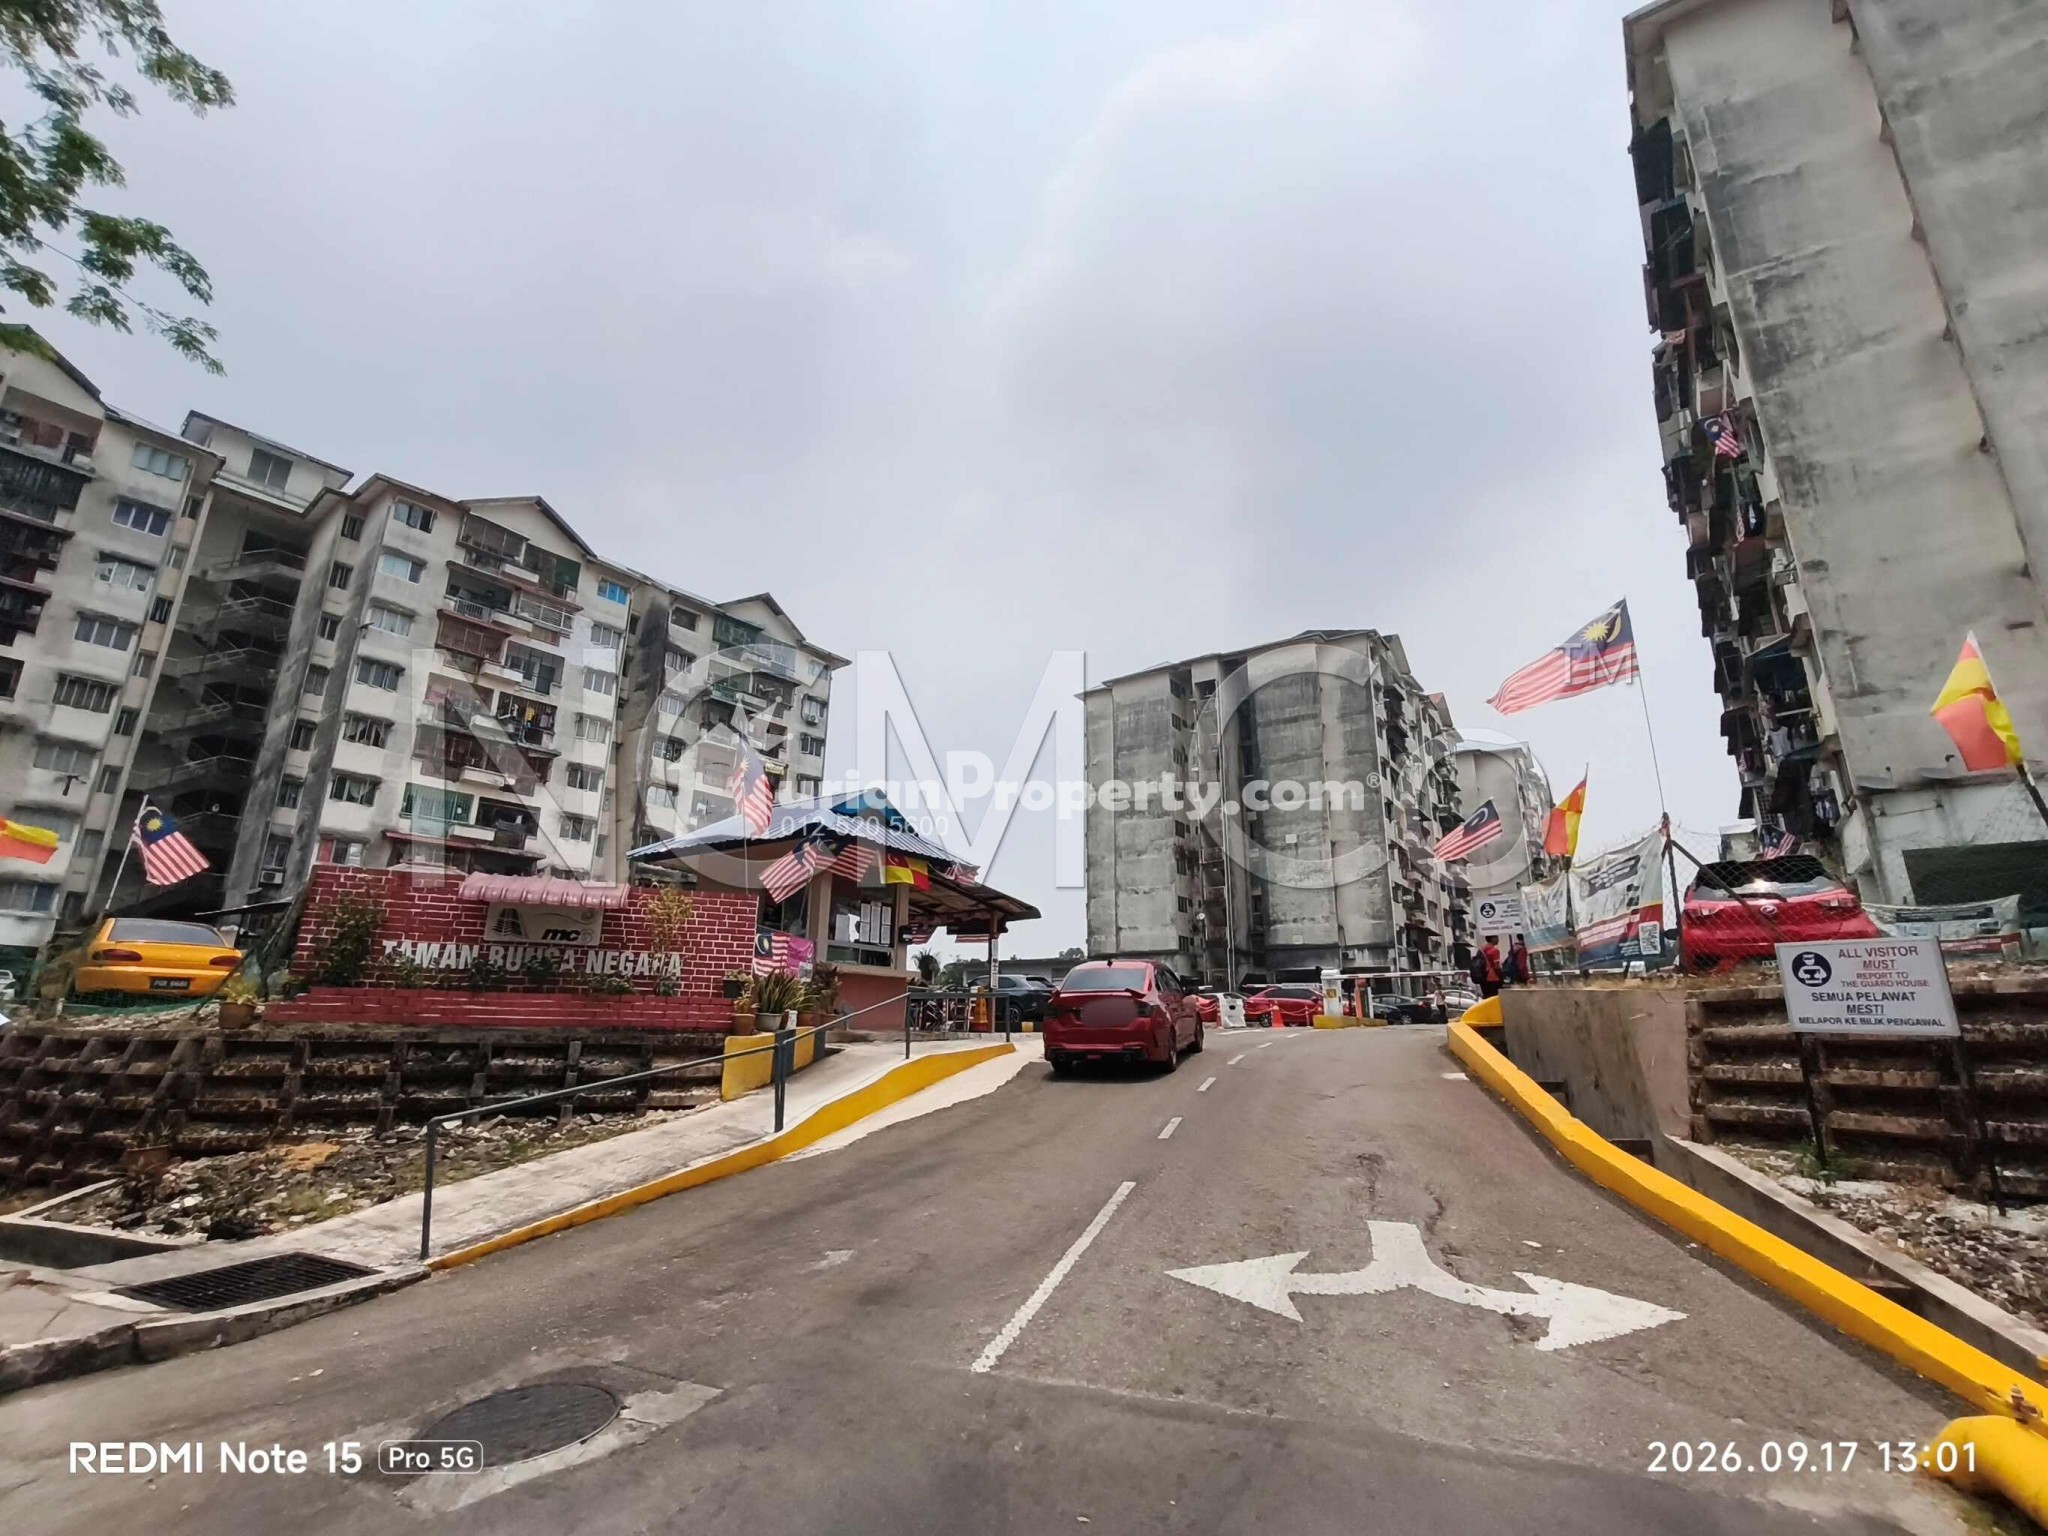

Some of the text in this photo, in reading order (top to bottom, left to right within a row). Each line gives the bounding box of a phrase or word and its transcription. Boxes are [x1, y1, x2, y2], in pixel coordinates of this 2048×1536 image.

[382, 940, 479, 970] TAMAN
[1838, 946, 1918, 958] ALL VISITOR
[1863, 959, 1896, 969] MUST
[1811, 992, 1916, 1001] SEMUA PELAWAT
[1847, 1004, 1884, 1013] MESTI
[1799, 1017, 1842, 1025] MELAPOR
[1887, 1018, 1945, 1026] PENGAWAL
